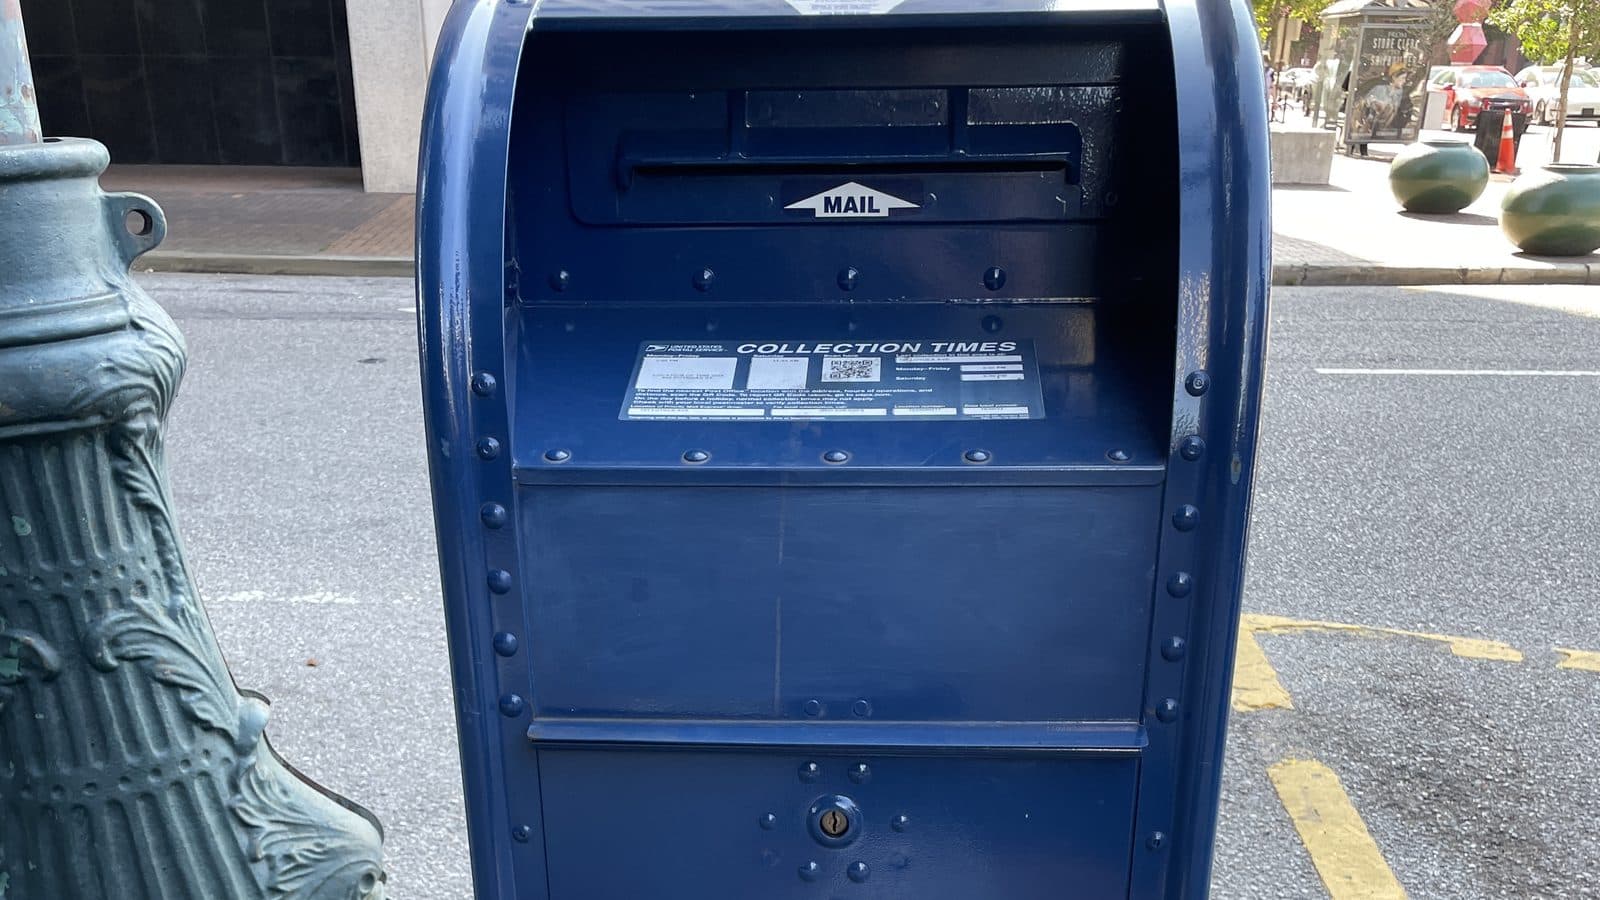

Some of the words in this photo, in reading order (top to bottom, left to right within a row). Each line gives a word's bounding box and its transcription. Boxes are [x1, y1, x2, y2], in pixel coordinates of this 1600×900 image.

[1373, 38, 1396, 50] STORE
[823, 196, 881, 214] MAIL
[737, 343, 921, 354] COLLECTION
[931, 342, 1017, 353] TIMES
